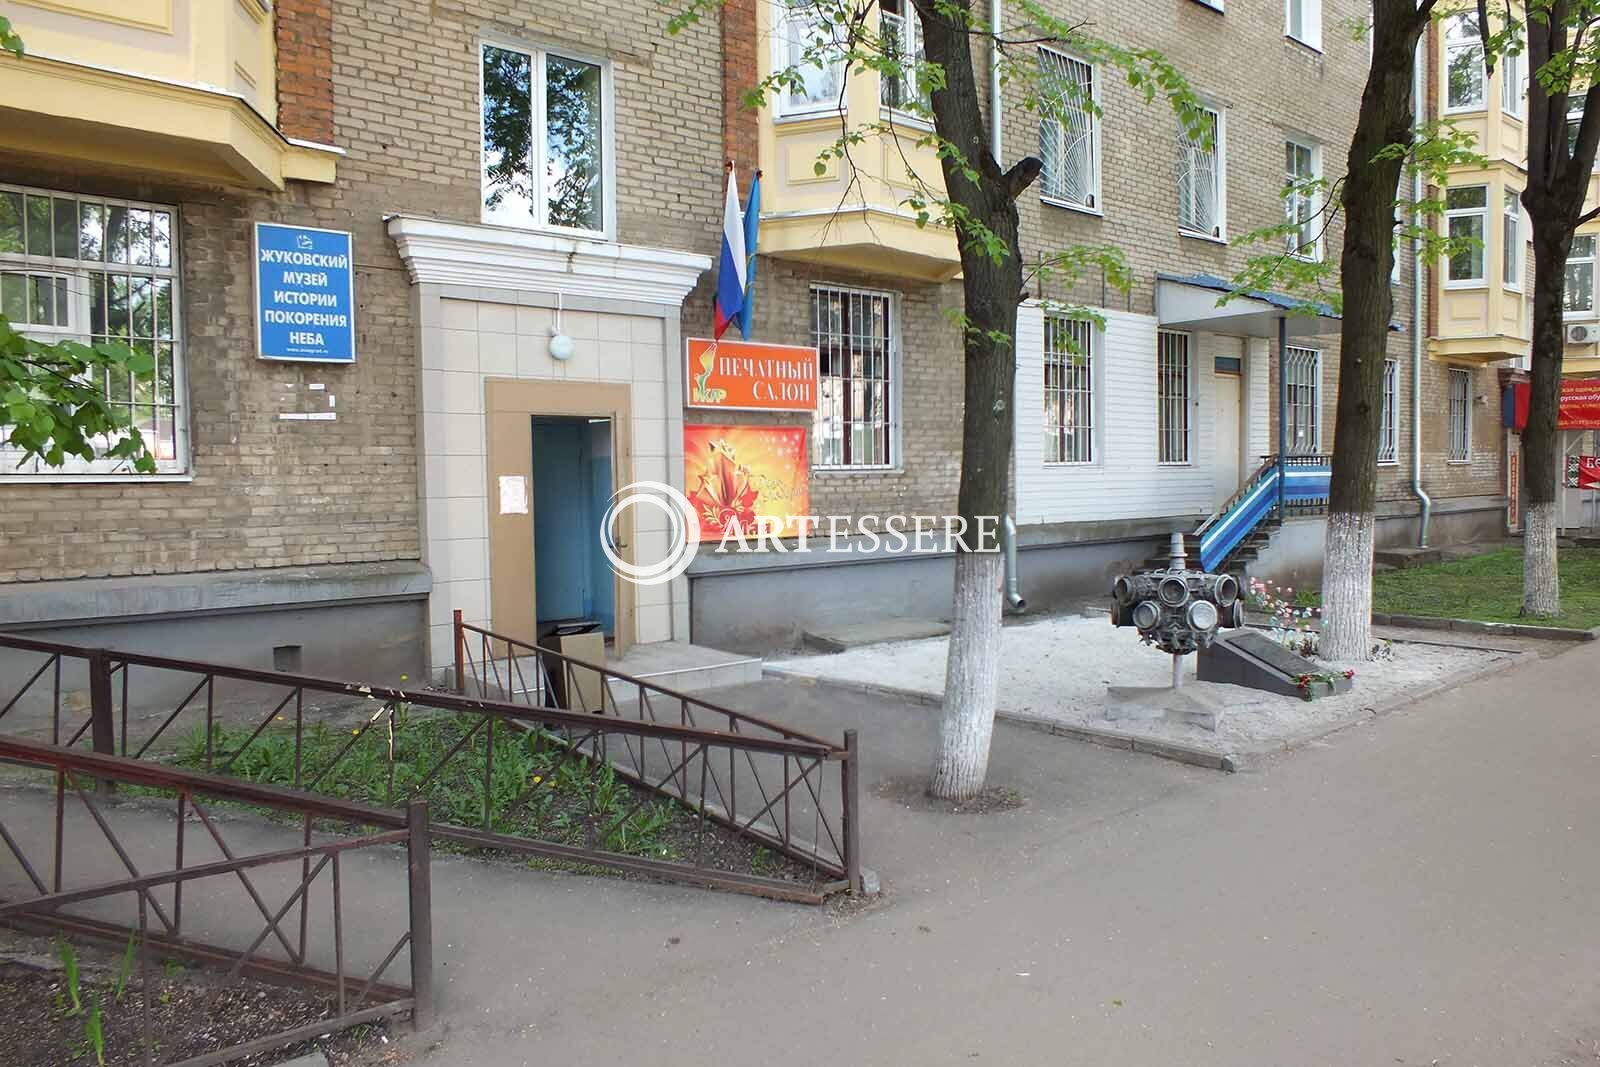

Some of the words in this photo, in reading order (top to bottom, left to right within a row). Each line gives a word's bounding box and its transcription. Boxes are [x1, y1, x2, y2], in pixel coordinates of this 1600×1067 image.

[261, 249, 348, 269] ЖУКОВСКИЙ
[283, 271, 328, 287] МУЗЕЙ
[274, 290, 337, 307] ИСТОРИИ
[264, 310, 347, 327] ПОКОРЕНИЯ
[289, 331, 325, 345] НЕБА
[719, 356, 814, 380] ПЕЧАТНЫЙ
[752, 381, 811, 401] САЛОН
